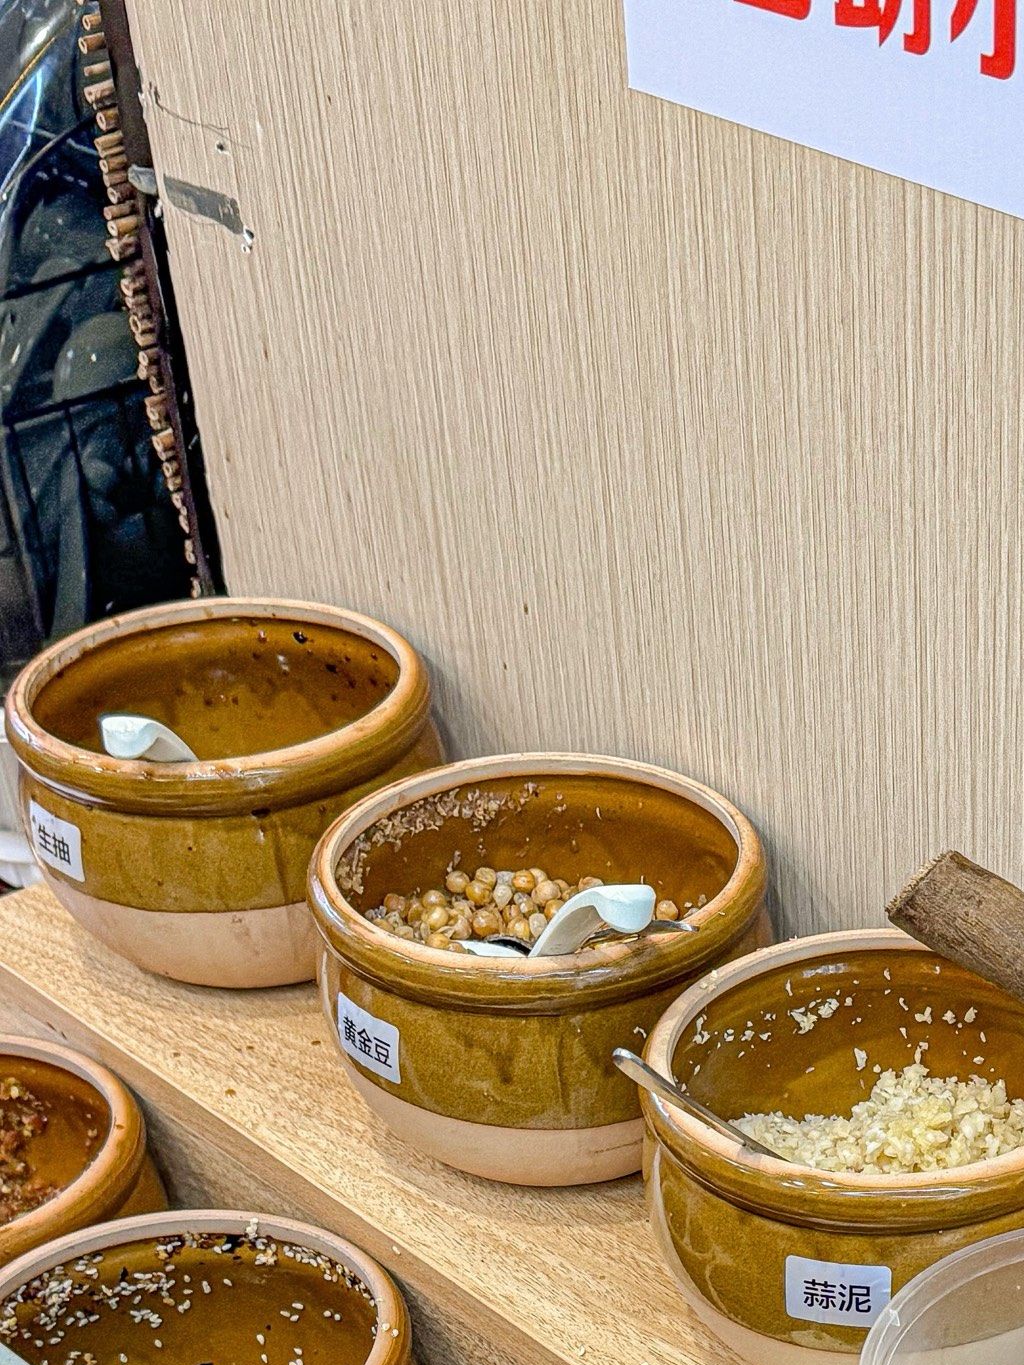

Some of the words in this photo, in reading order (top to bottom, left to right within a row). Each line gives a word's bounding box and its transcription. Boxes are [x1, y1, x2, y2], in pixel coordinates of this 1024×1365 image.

[38, 823, 71, 866] 生抽
[343, 1016, 392, 1068] 黄金豆
[803, 1279, 871, 1313] 蒜泥
